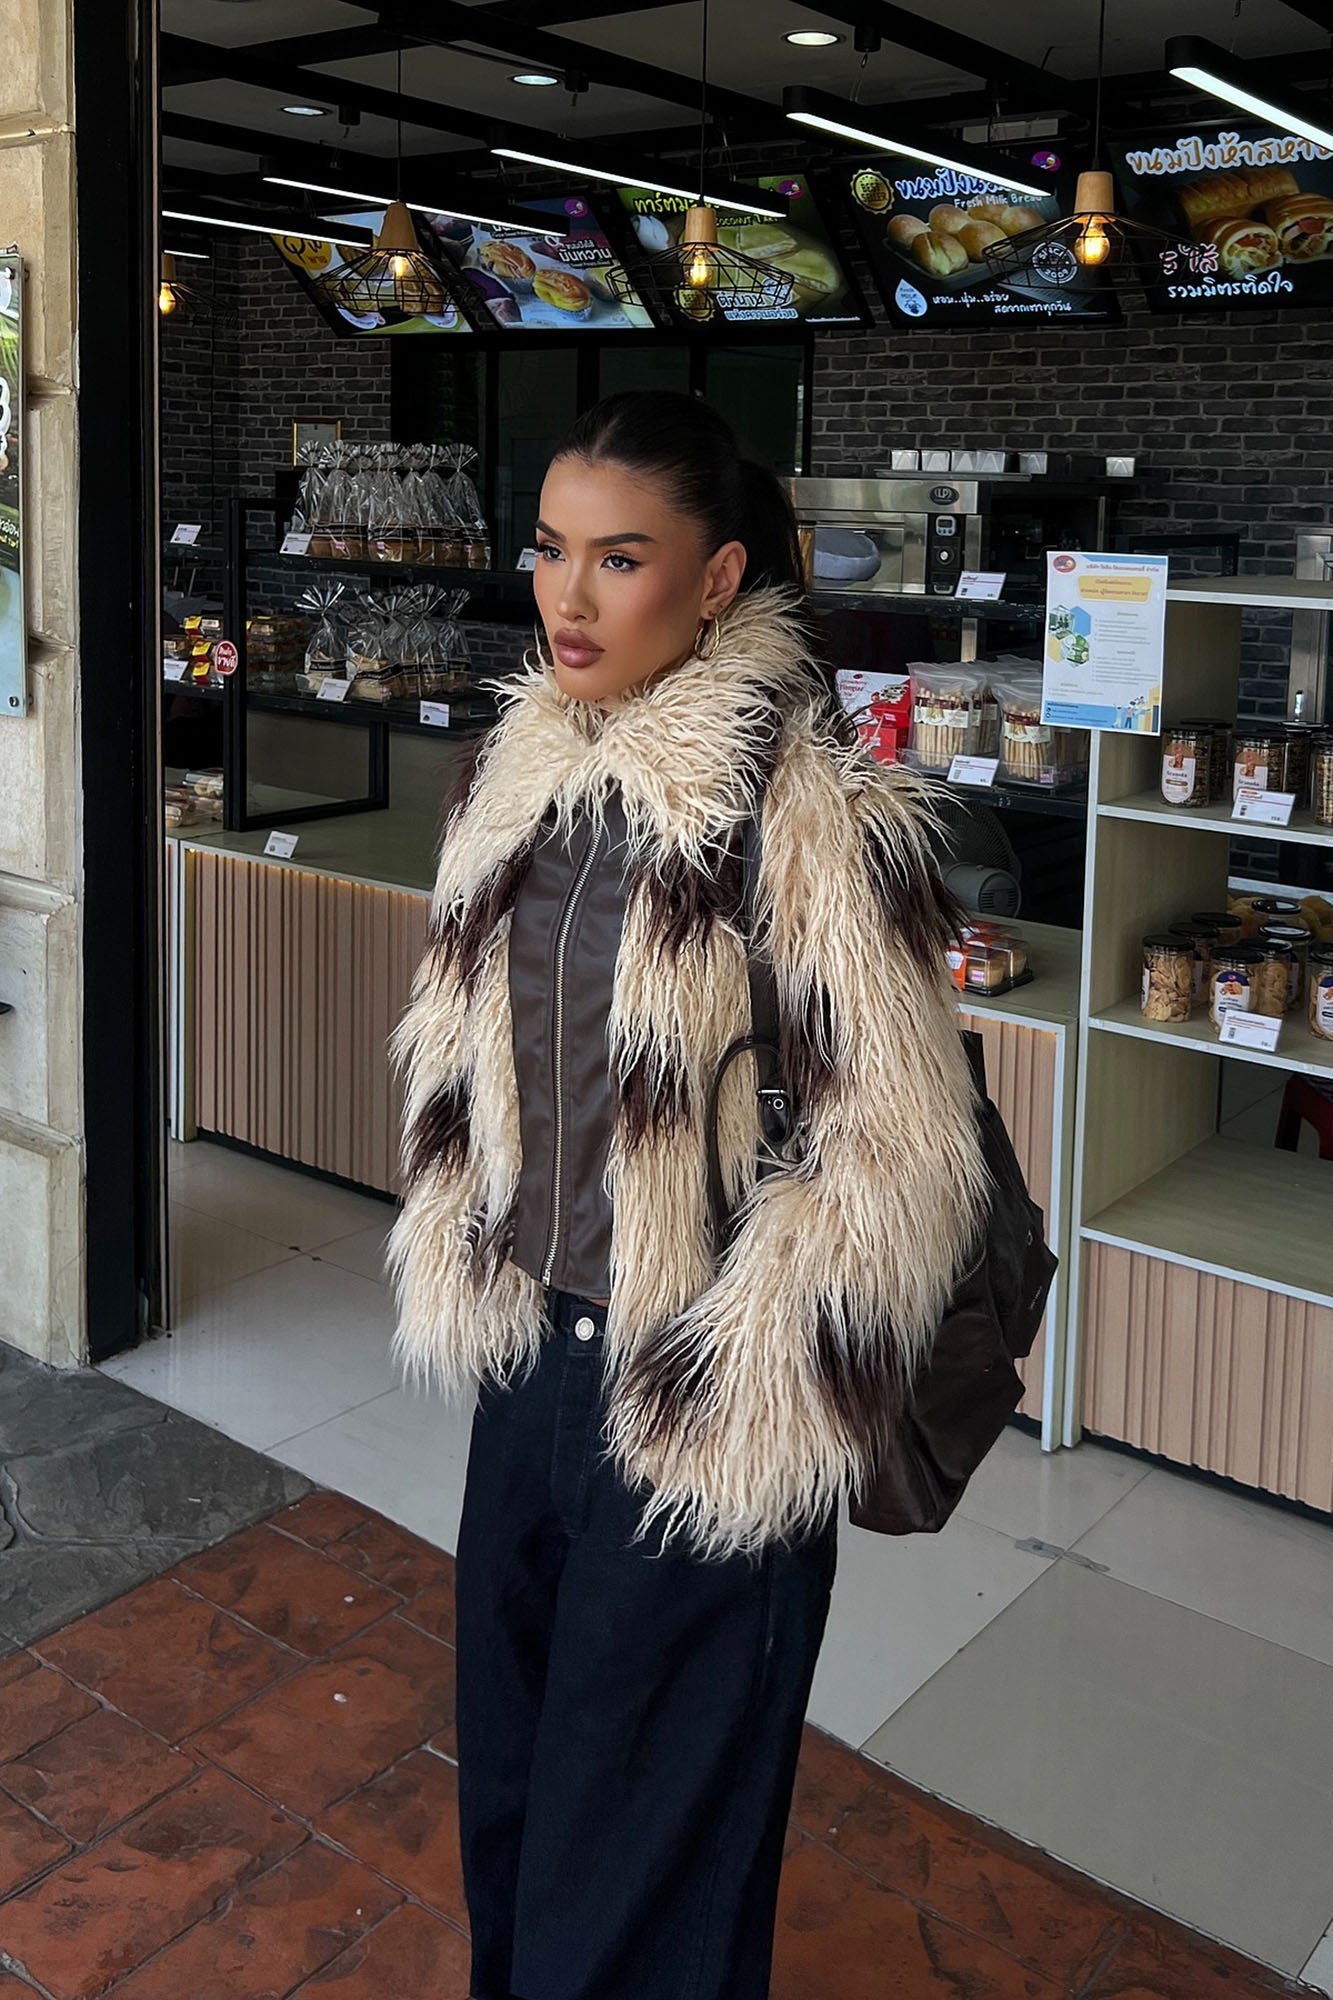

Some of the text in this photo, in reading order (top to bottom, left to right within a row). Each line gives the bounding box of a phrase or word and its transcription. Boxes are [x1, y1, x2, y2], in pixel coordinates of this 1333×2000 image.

[953, 195, 984, 208] Fresh
[985, 194, 1009, 206] Milk
[559, 248, 613, 263] มันหวาน
[1044, 267, 1069, 279] 2009
[1167, 271, 1295, 300] รวมมิตรติดใจ
[724, 307, 799, 321] แห่งความอร่อย
